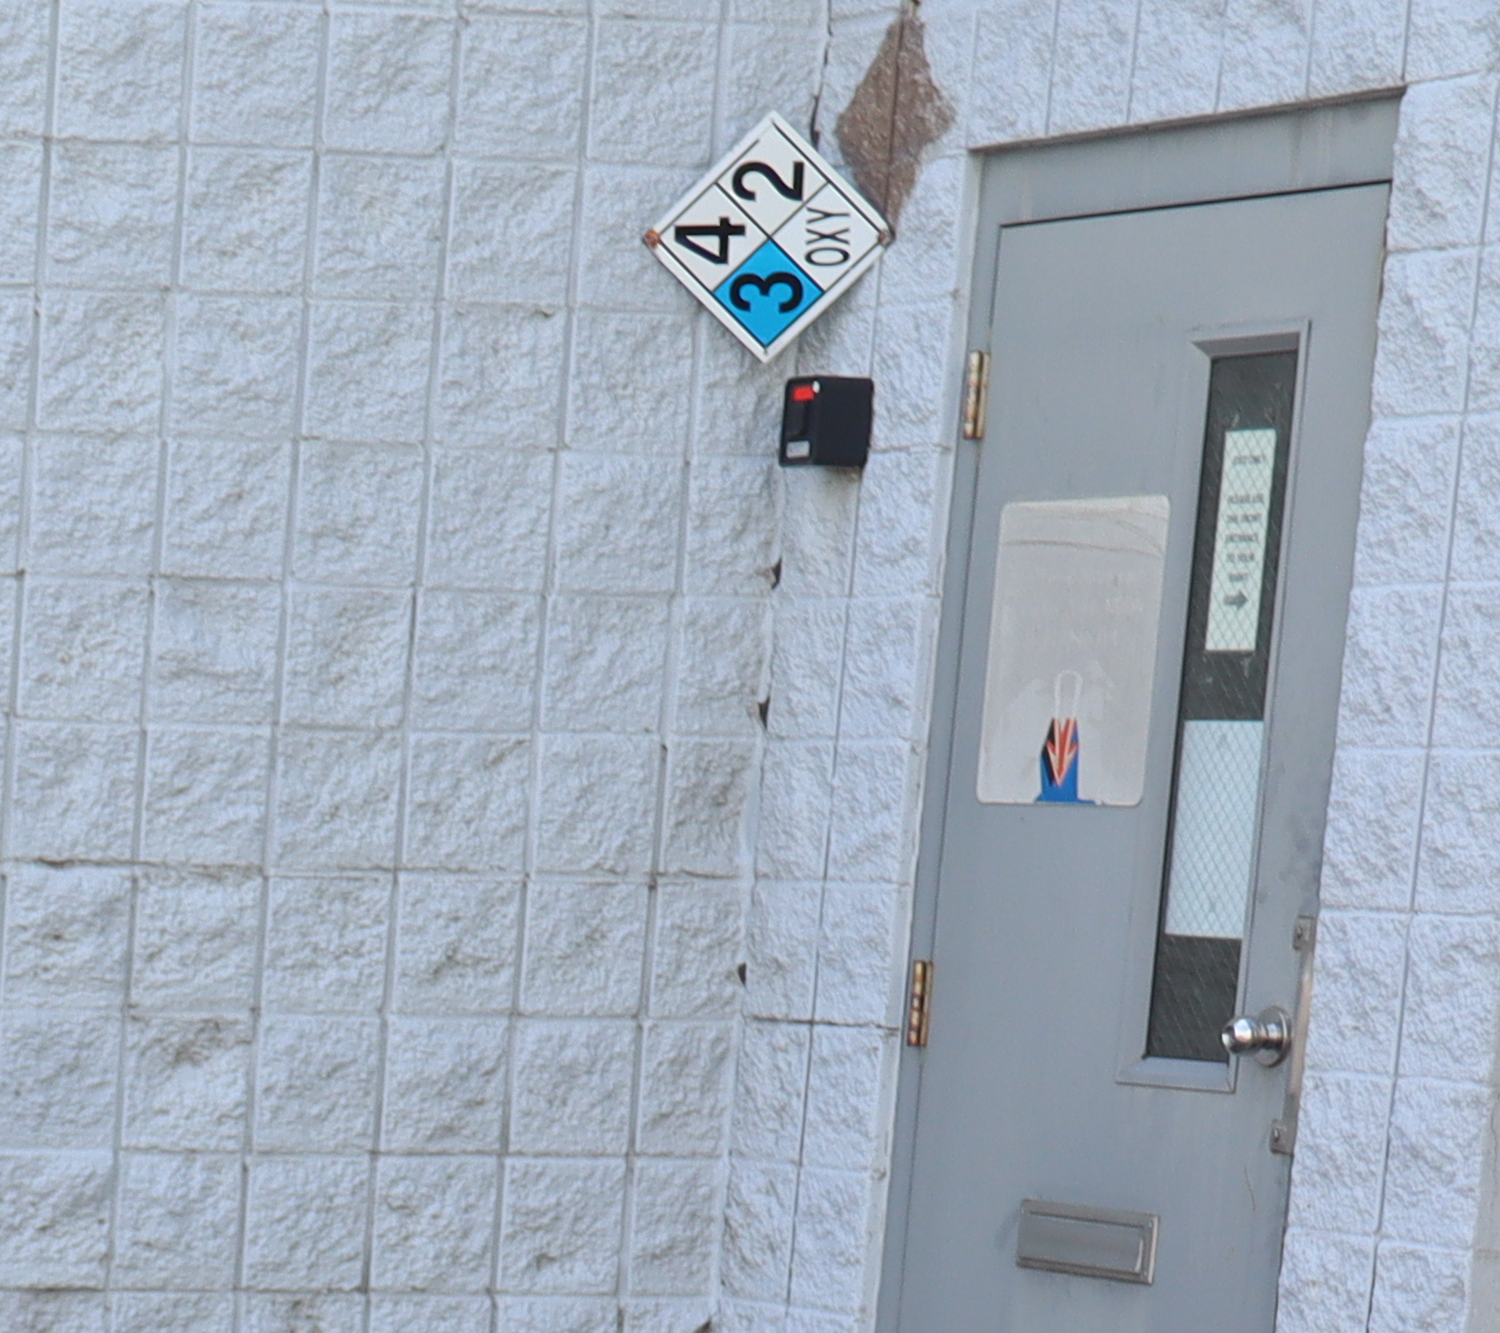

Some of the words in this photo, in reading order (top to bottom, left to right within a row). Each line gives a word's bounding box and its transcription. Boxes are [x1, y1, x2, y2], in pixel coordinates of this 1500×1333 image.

[732, 161, 804, 201] 2
[675, 217, 745, 264] 4
[805, 207, 850, 267] OXY
[730, 272, 803, 313] 3
